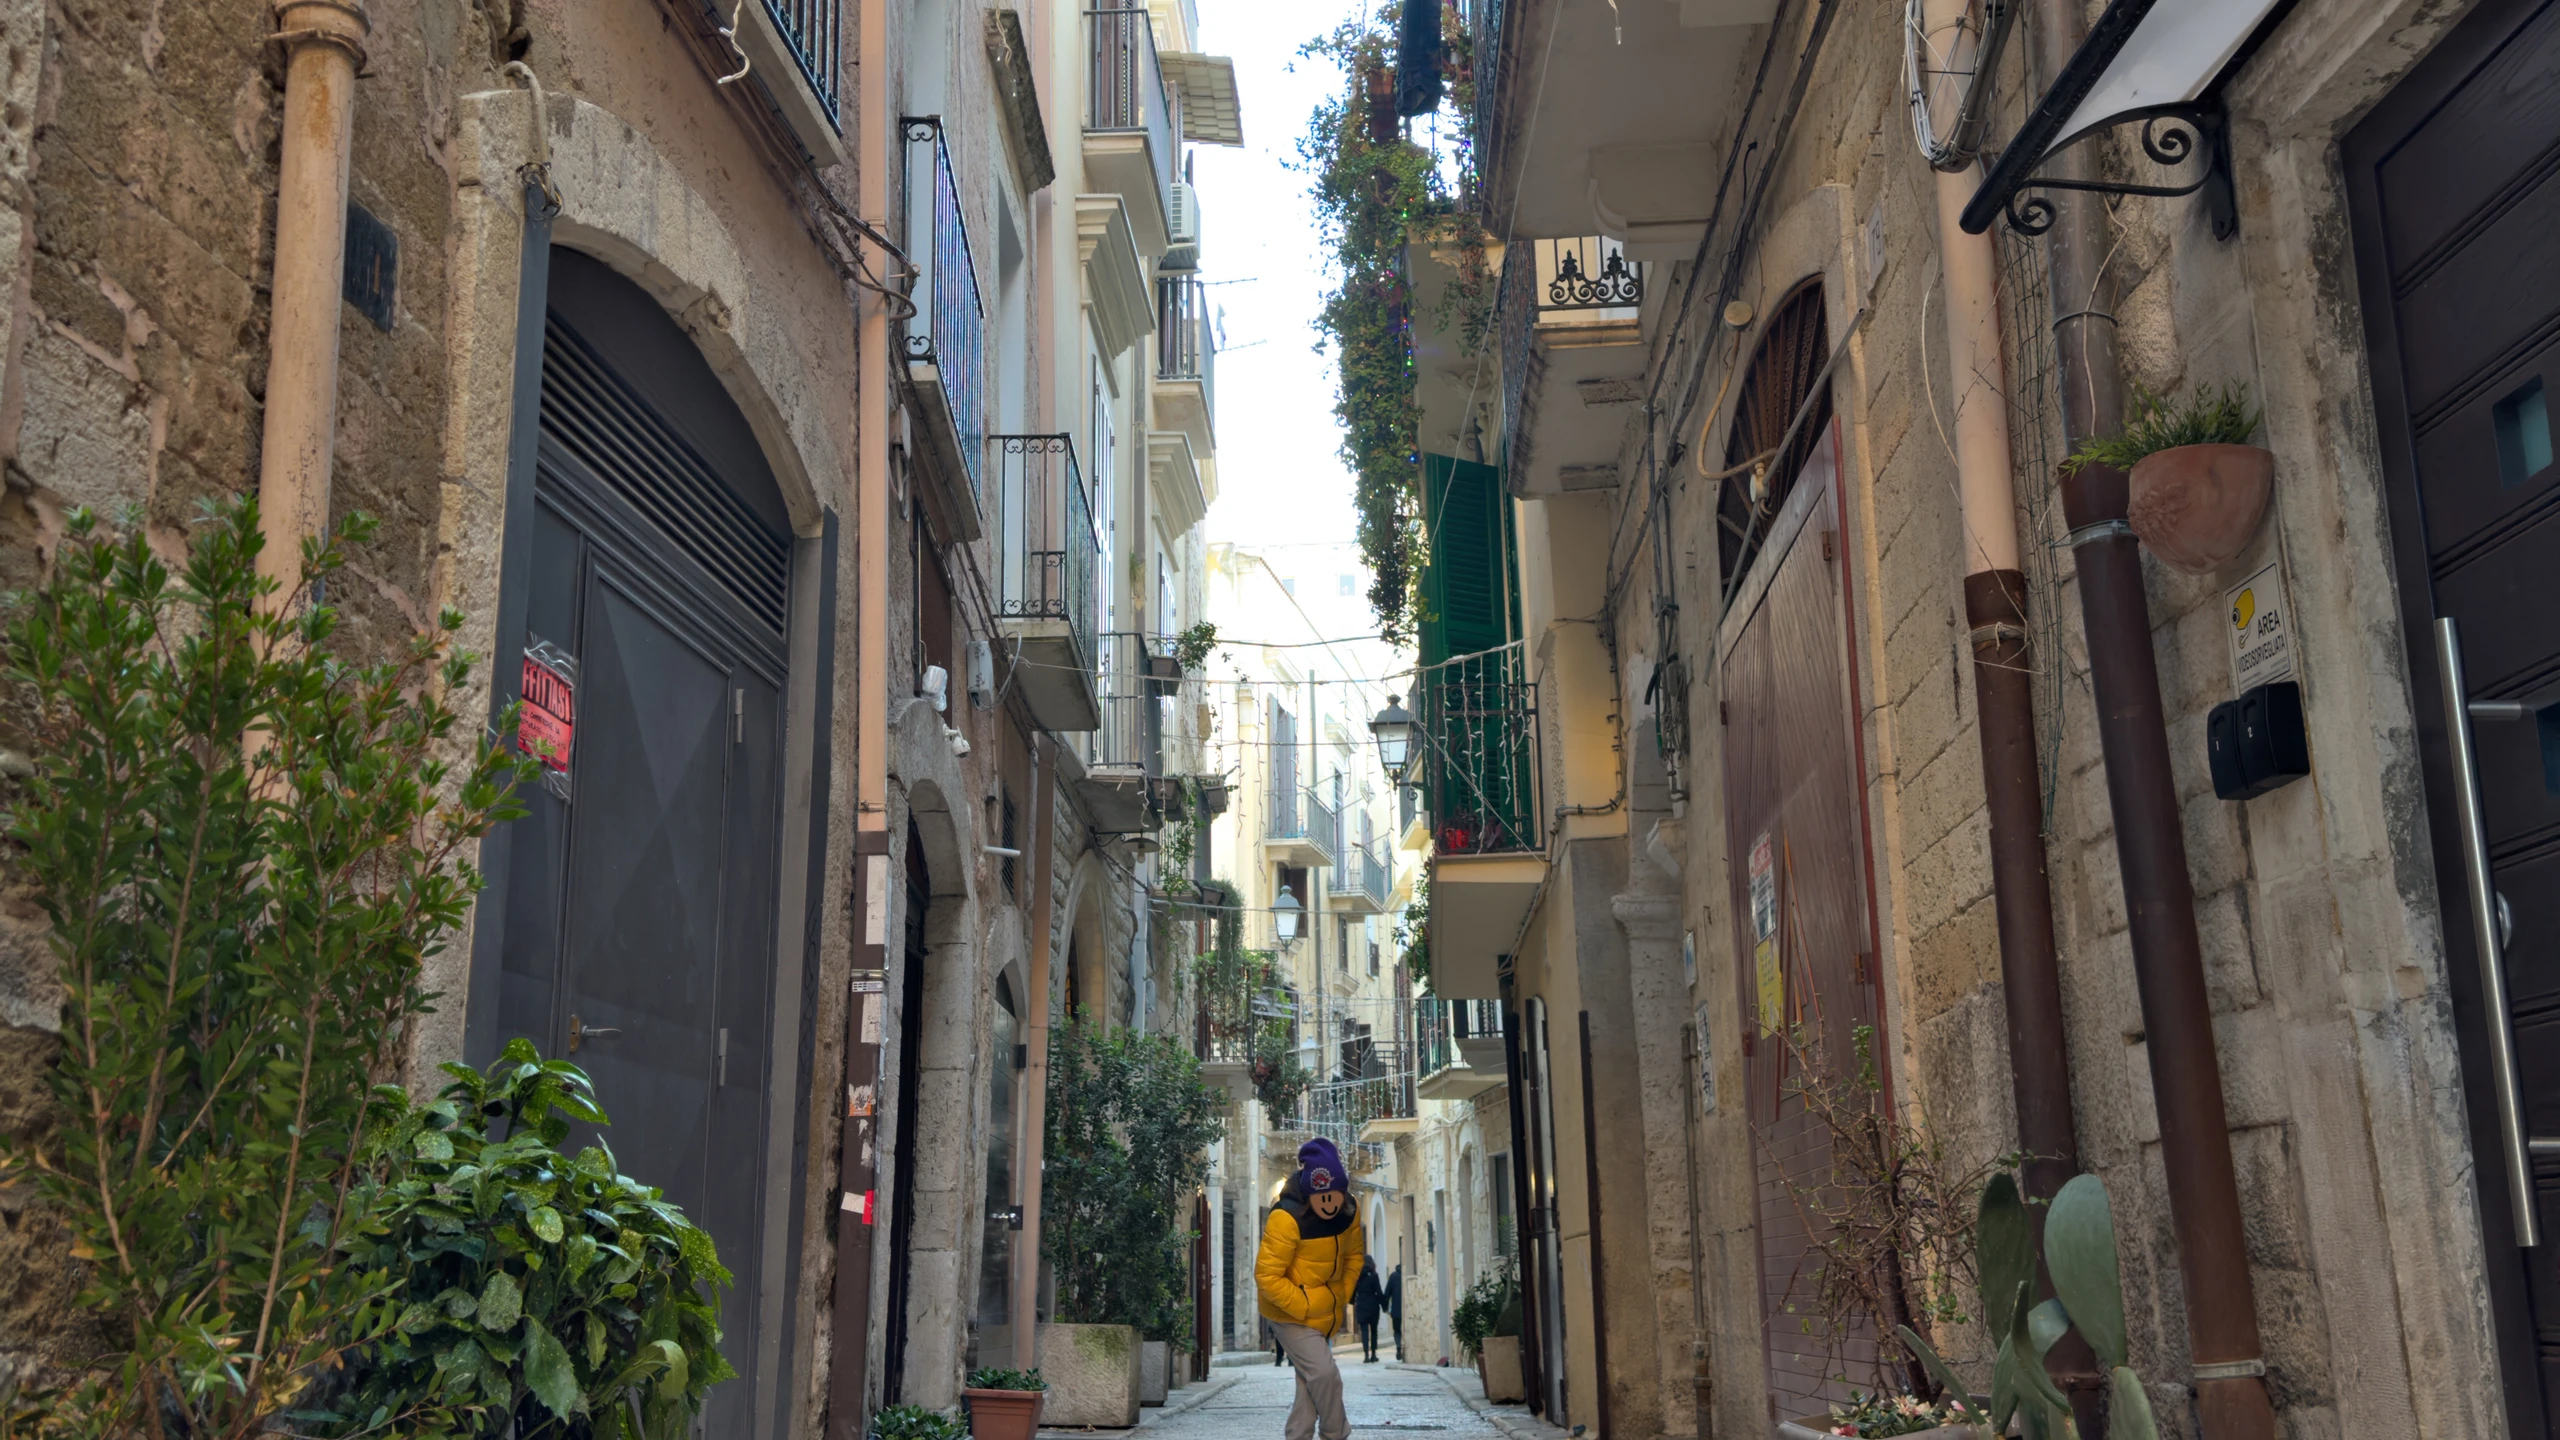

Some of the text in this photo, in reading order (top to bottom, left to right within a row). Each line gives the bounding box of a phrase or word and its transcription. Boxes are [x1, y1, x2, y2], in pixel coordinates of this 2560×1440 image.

[2257, 609, 2281, 639] AREA
[2238, 634, 2286, 675] VIDEOSORVEGLIATA
[522, 659, 571, 723] FFITTASI
[2215, 740, 2220, 751] 1
[2247, 726, 2254, 738] 2
